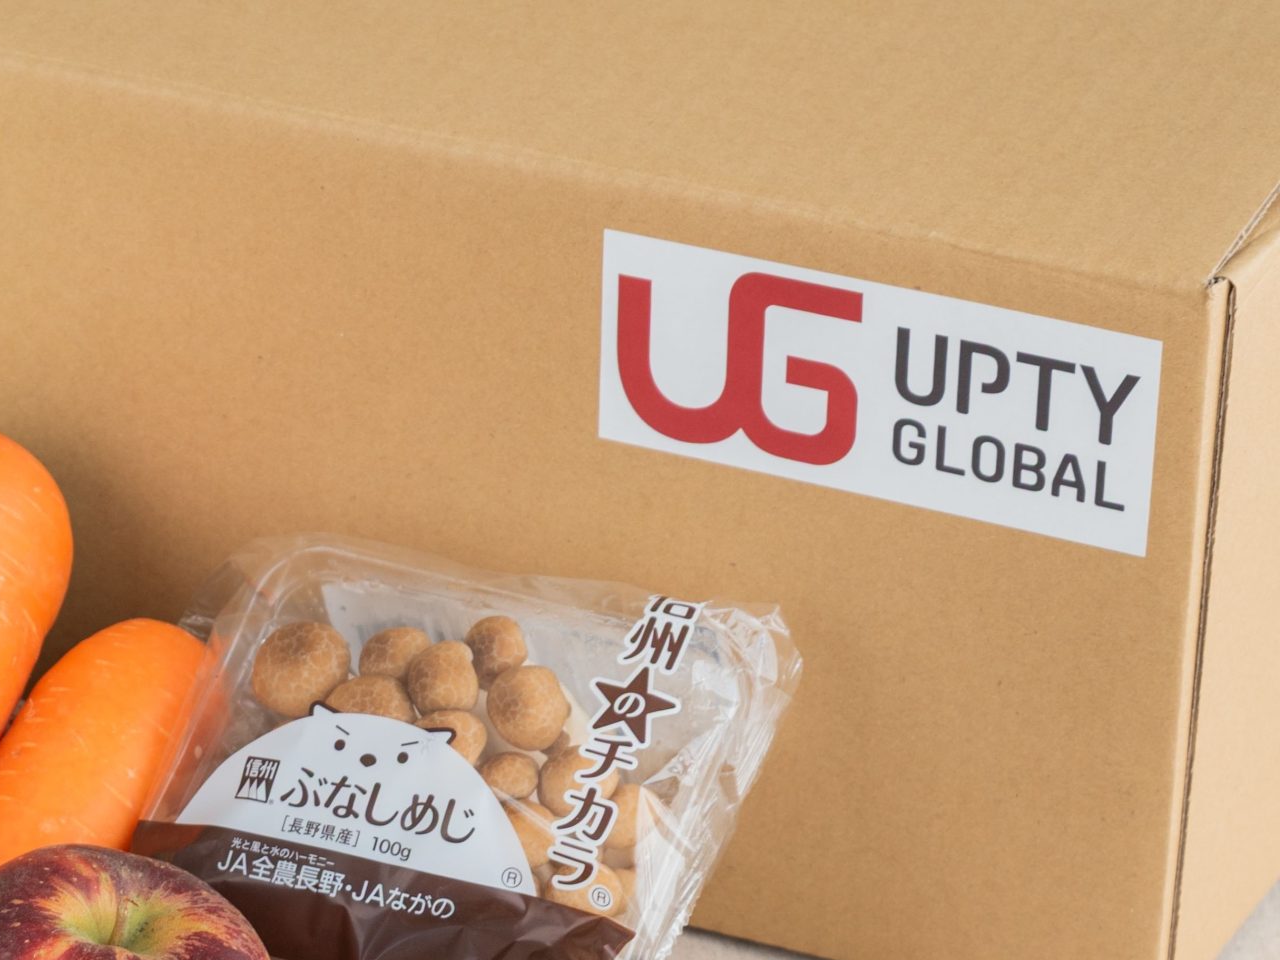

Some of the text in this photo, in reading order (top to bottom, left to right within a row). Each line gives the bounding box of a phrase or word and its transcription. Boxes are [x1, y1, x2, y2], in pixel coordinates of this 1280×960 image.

[894, 326, 1142, 446] UPTY
[891, 418, 1126, 513] GLOBAL
[280, 767, 475, 844] ぶなしめじ
[217, 849, 455, 919] JA全農長野・JAながの
[231, 837, 336, 867] 光と風と水のハーモニー
[371, 836, 412, 861] 100g
